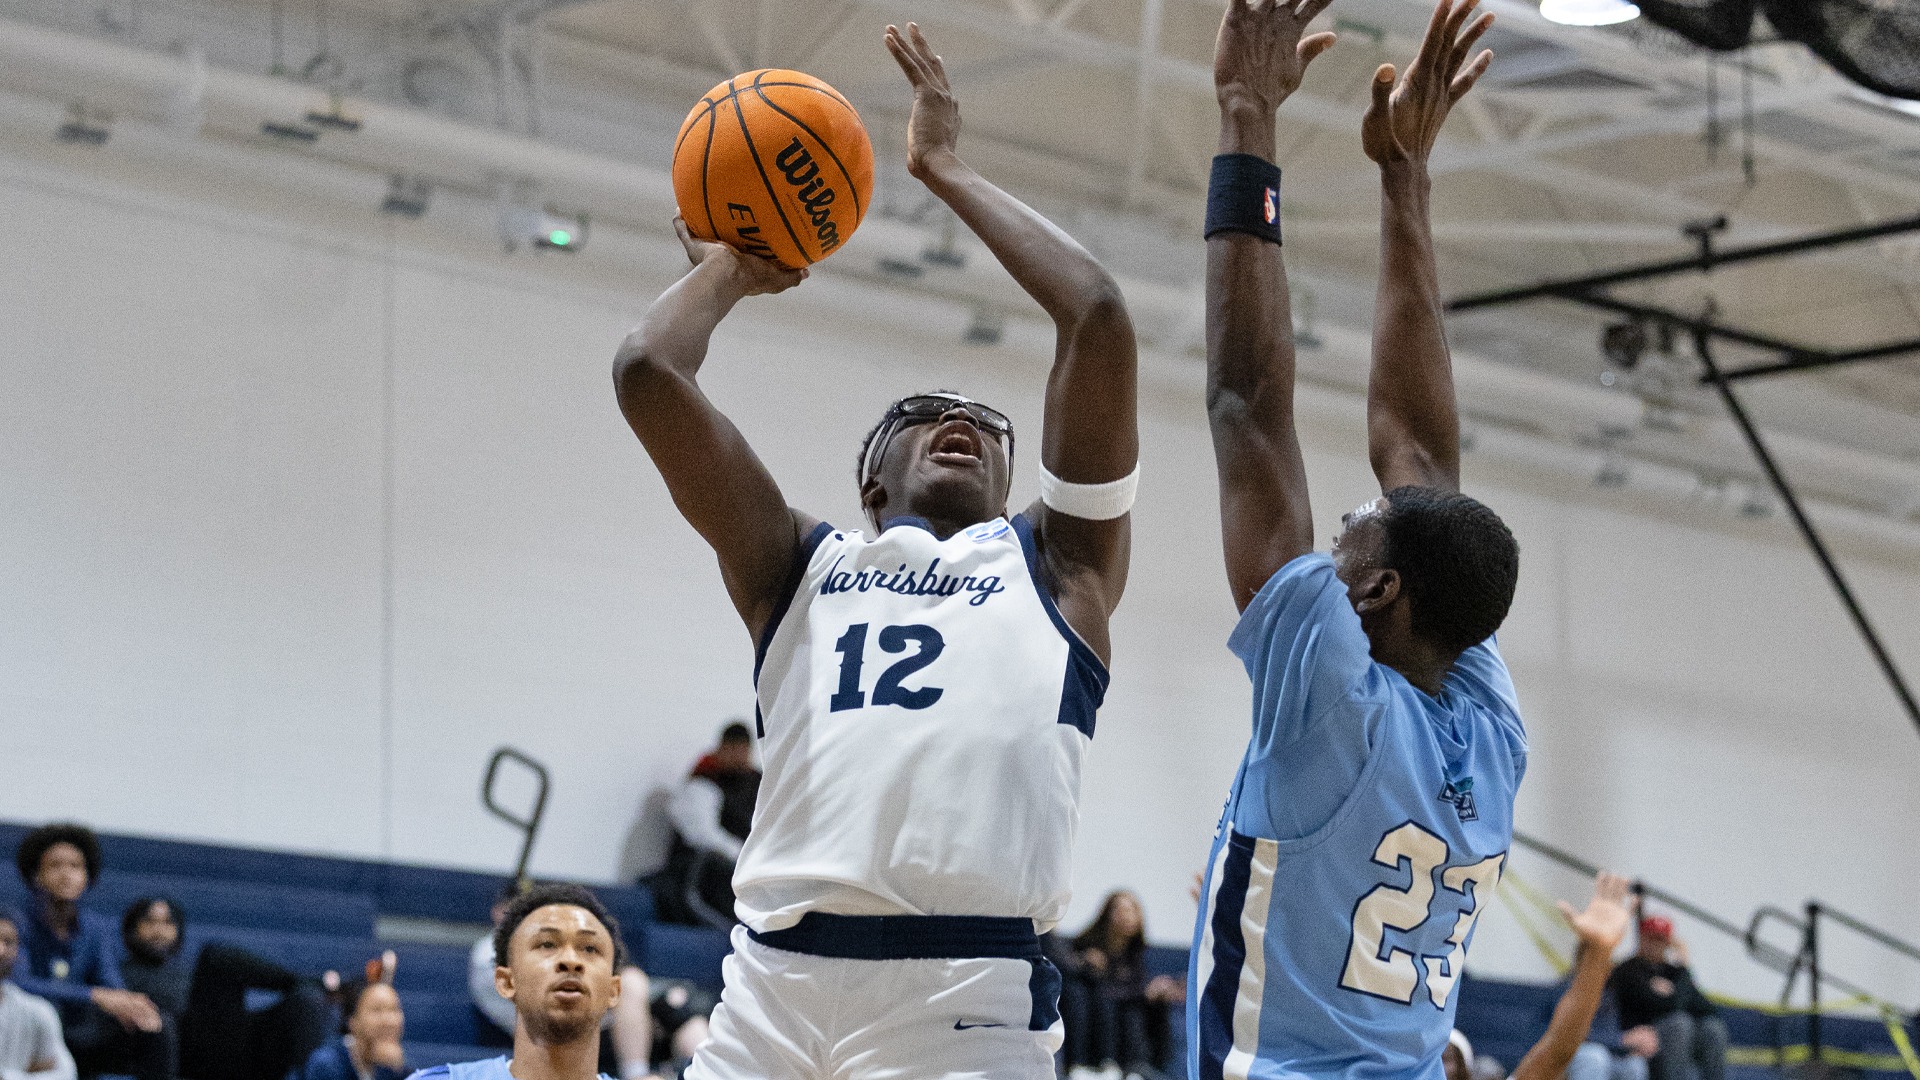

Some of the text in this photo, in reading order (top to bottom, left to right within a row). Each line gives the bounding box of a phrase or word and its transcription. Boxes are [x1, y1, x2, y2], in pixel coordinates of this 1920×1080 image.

[775, 136, 840, 254] Wilson
[830, 622, 946, 713] 12
[1337, 819, 1507, 1012] 23
